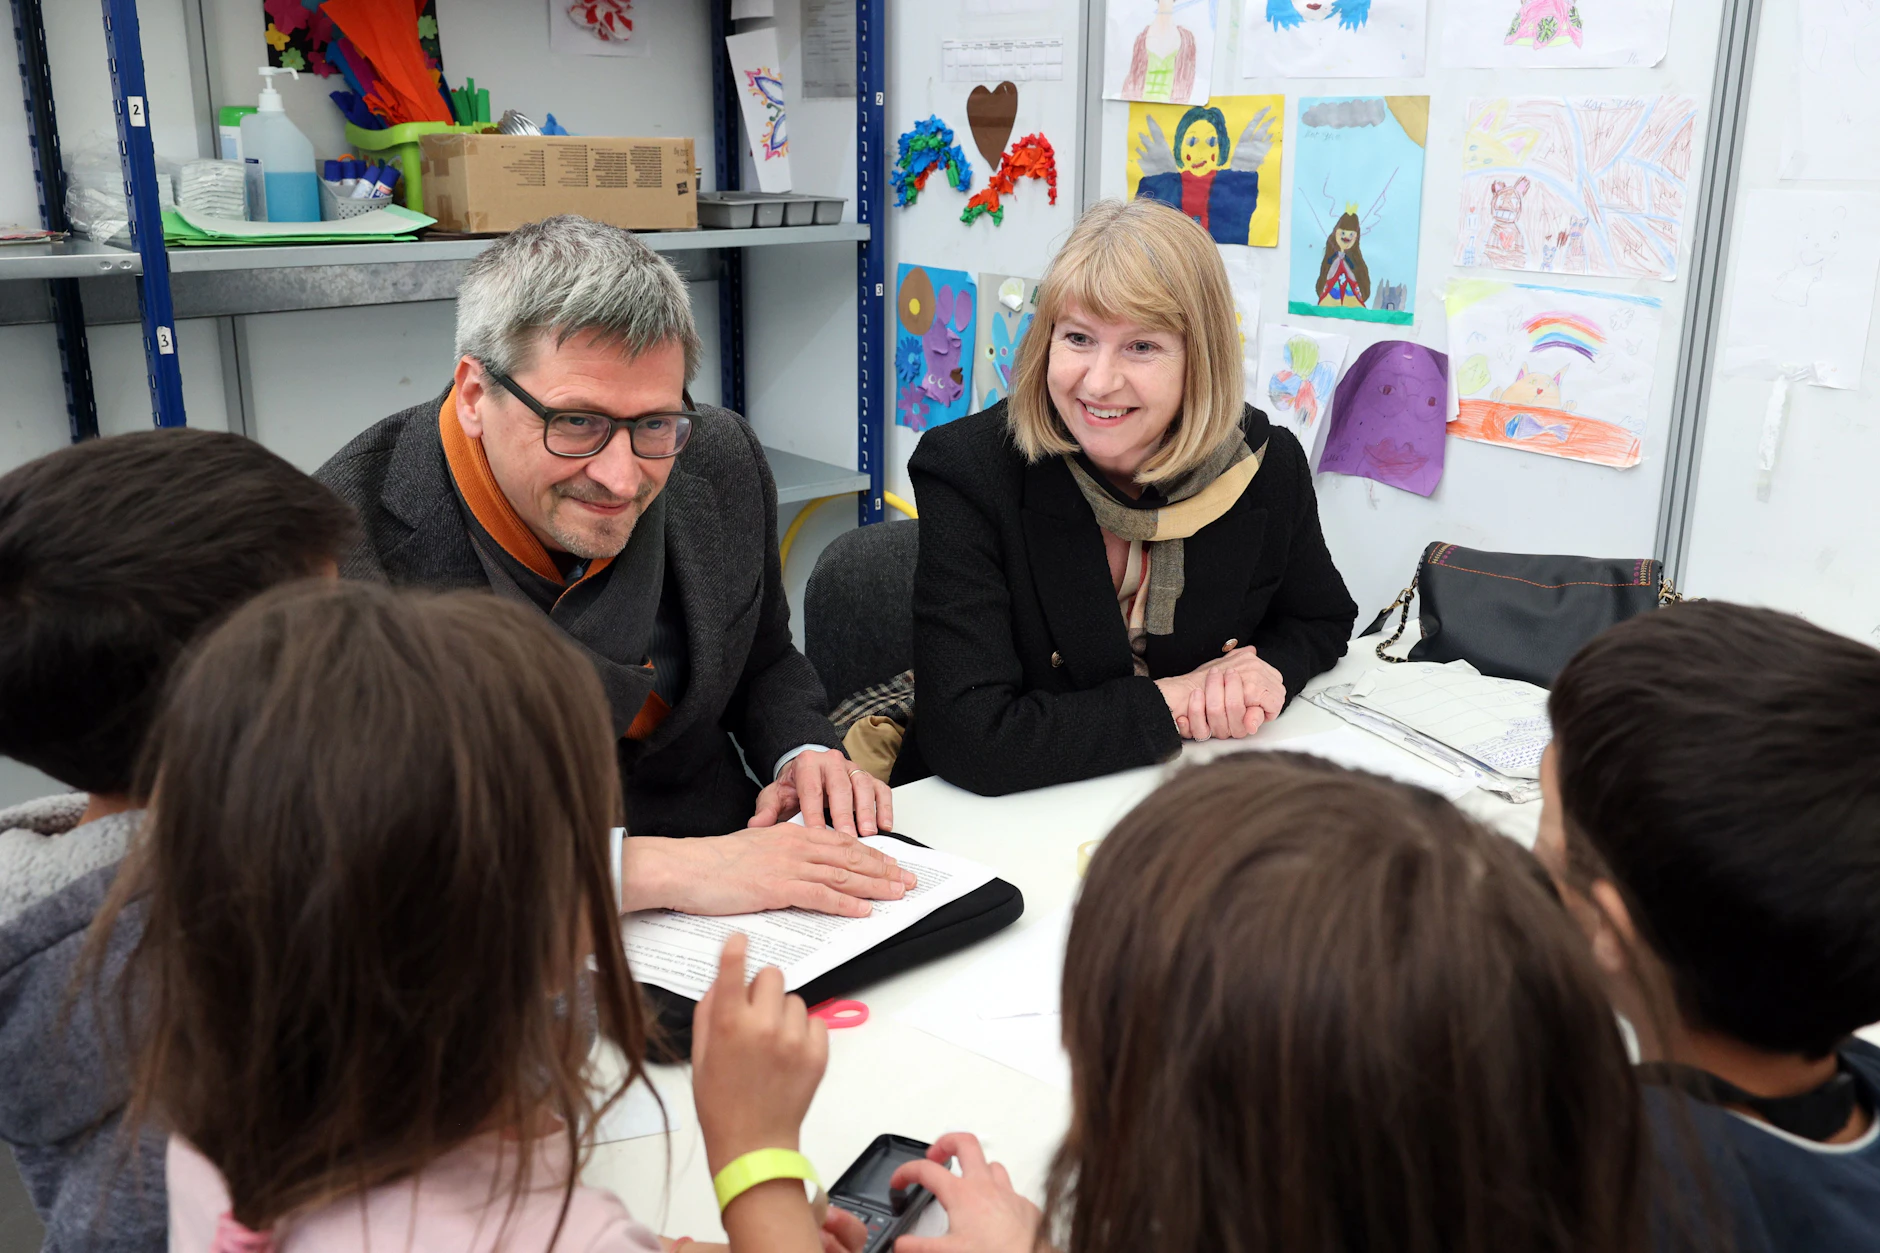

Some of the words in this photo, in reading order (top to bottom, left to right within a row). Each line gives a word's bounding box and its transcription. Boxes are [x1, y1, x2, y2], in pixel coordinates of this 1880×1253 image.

[877, 94, 882, 103] 2
[133, 104, 141, 115] 2
[877, 285, 882, 294] 3
[160, 334, 169, 348] 3
